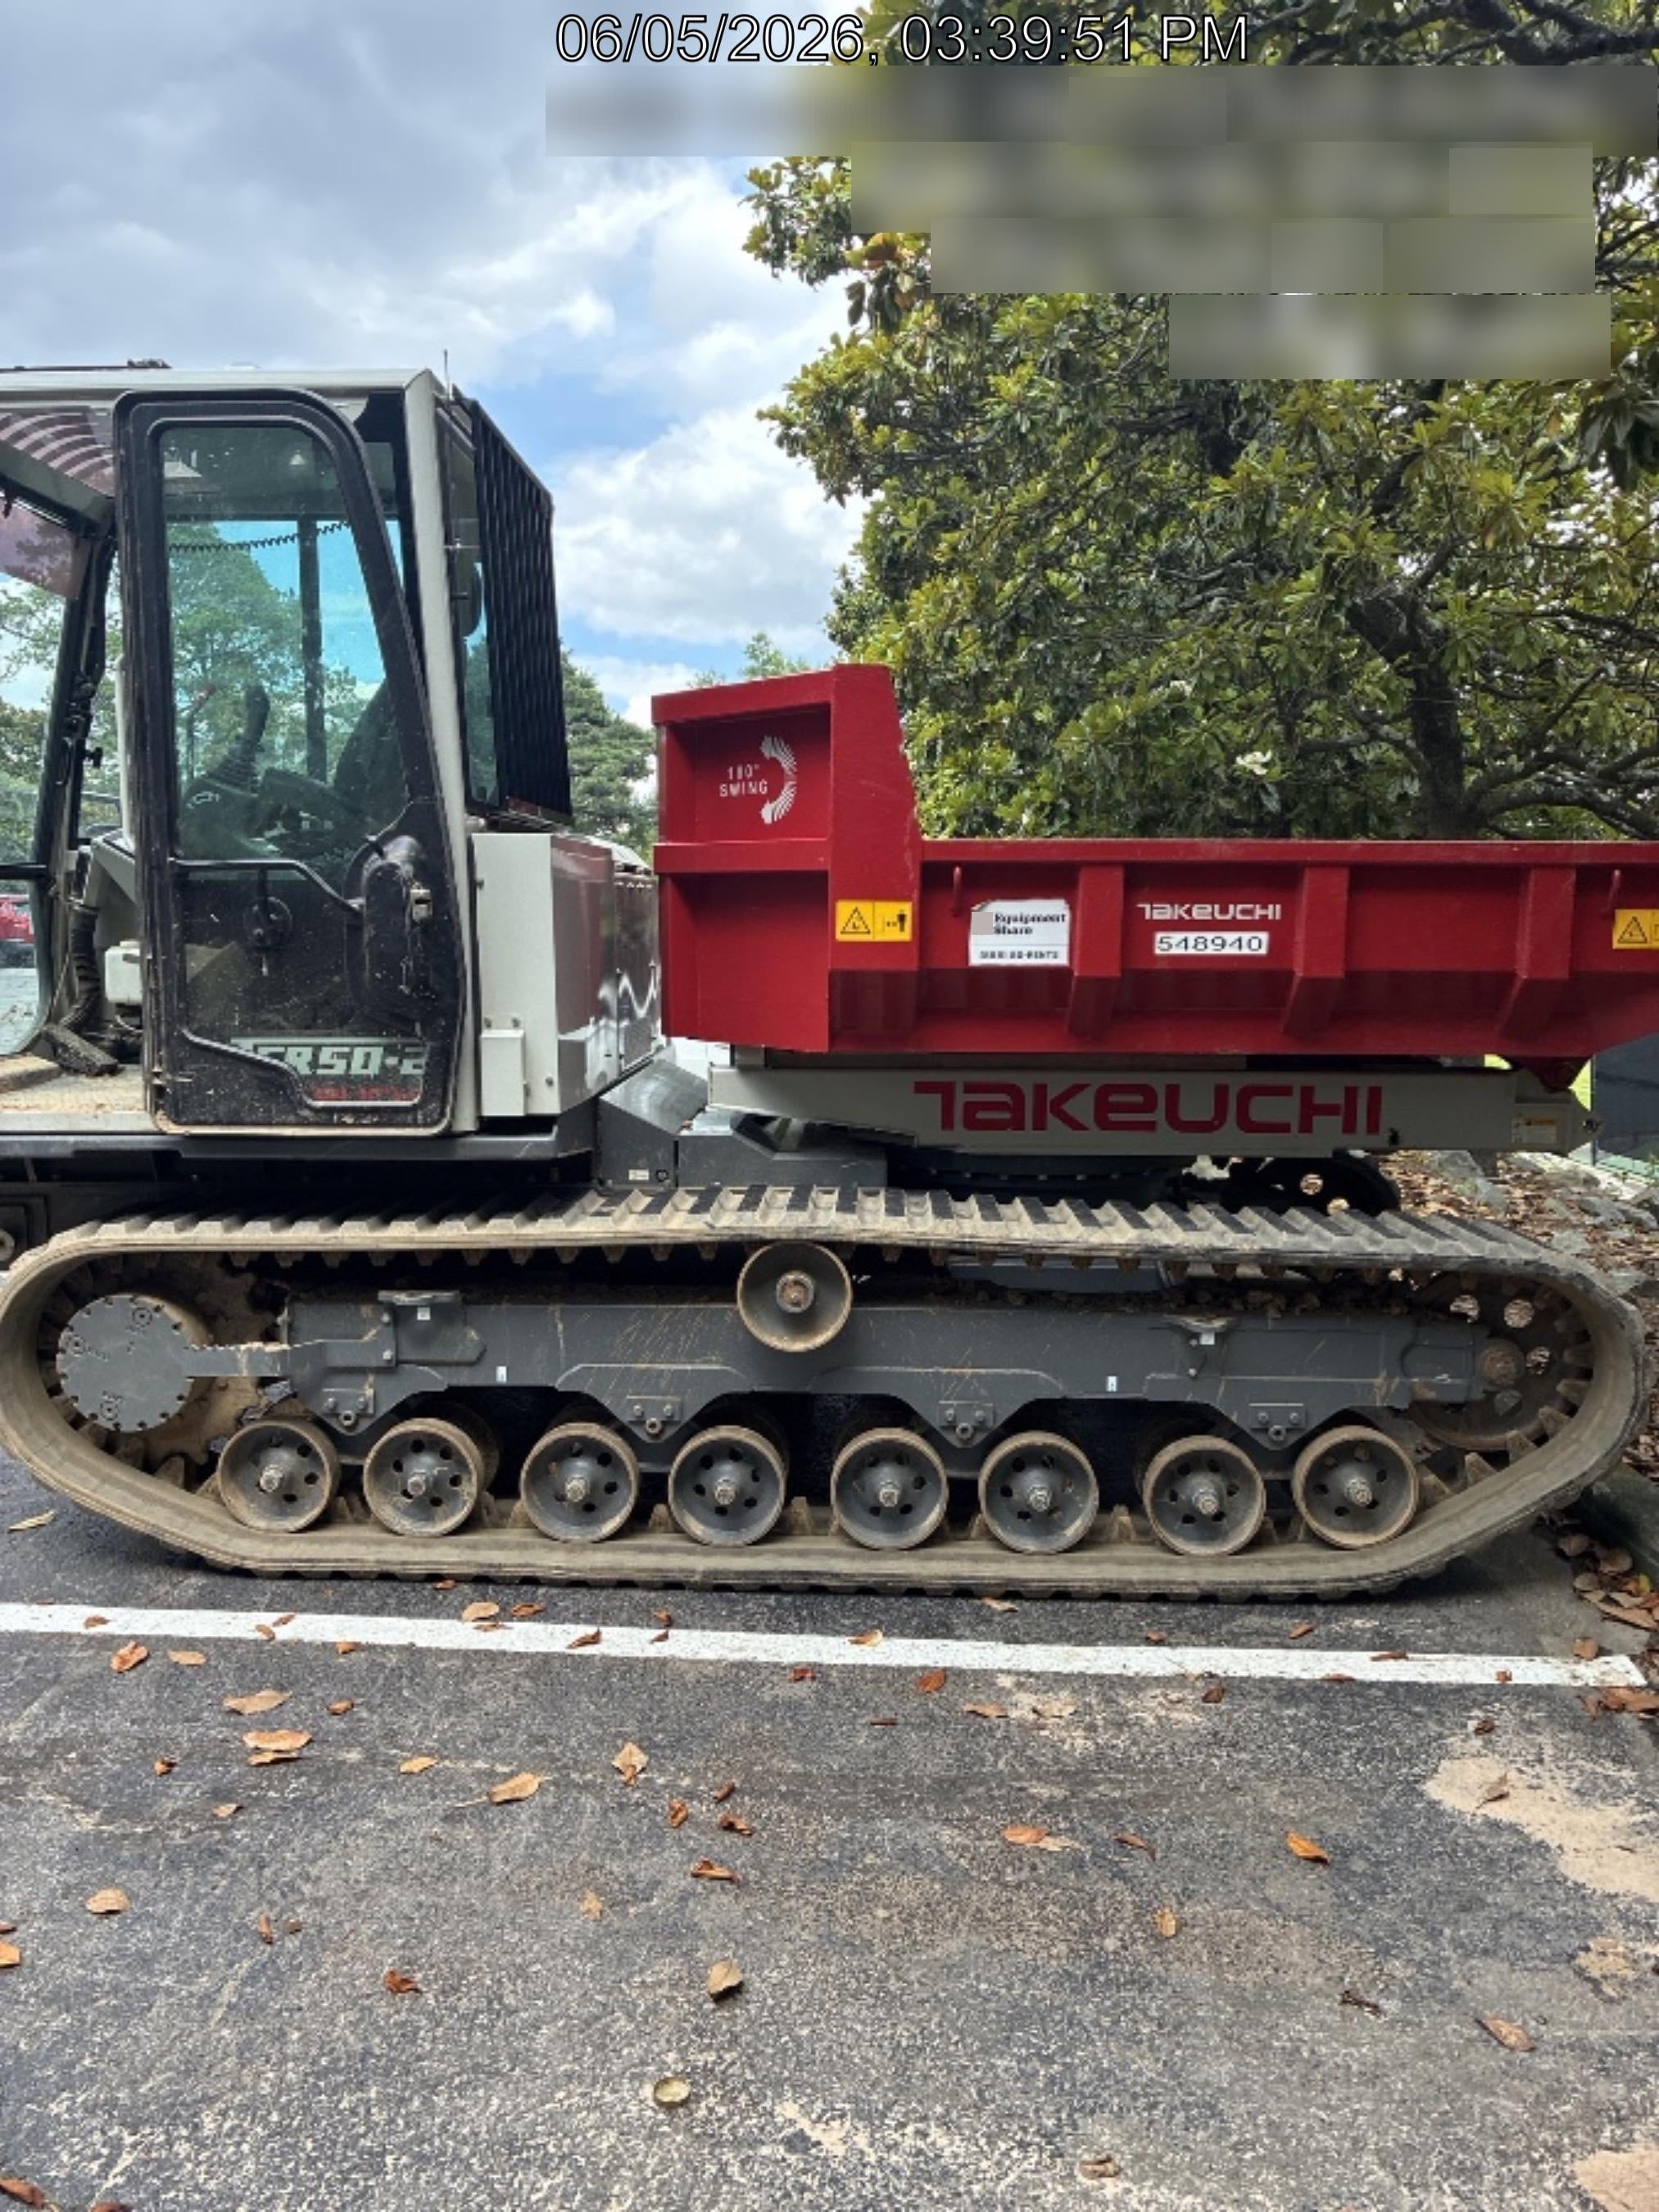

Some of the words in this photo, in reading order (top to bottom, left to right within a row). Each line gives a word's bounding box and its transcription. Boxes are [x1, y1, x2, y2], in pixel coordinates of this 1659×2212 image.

[719, 779, 768, 798] SWING
[995, 913, 1066, 925] Equipment
[1136, 903, 1282, 921] TAKEUCHI
[994, 926, 1033, 936] Share
[1157, 936, 1262, 952] 548940
[913, 1081, 1383, 1135] TAKEUCHI
